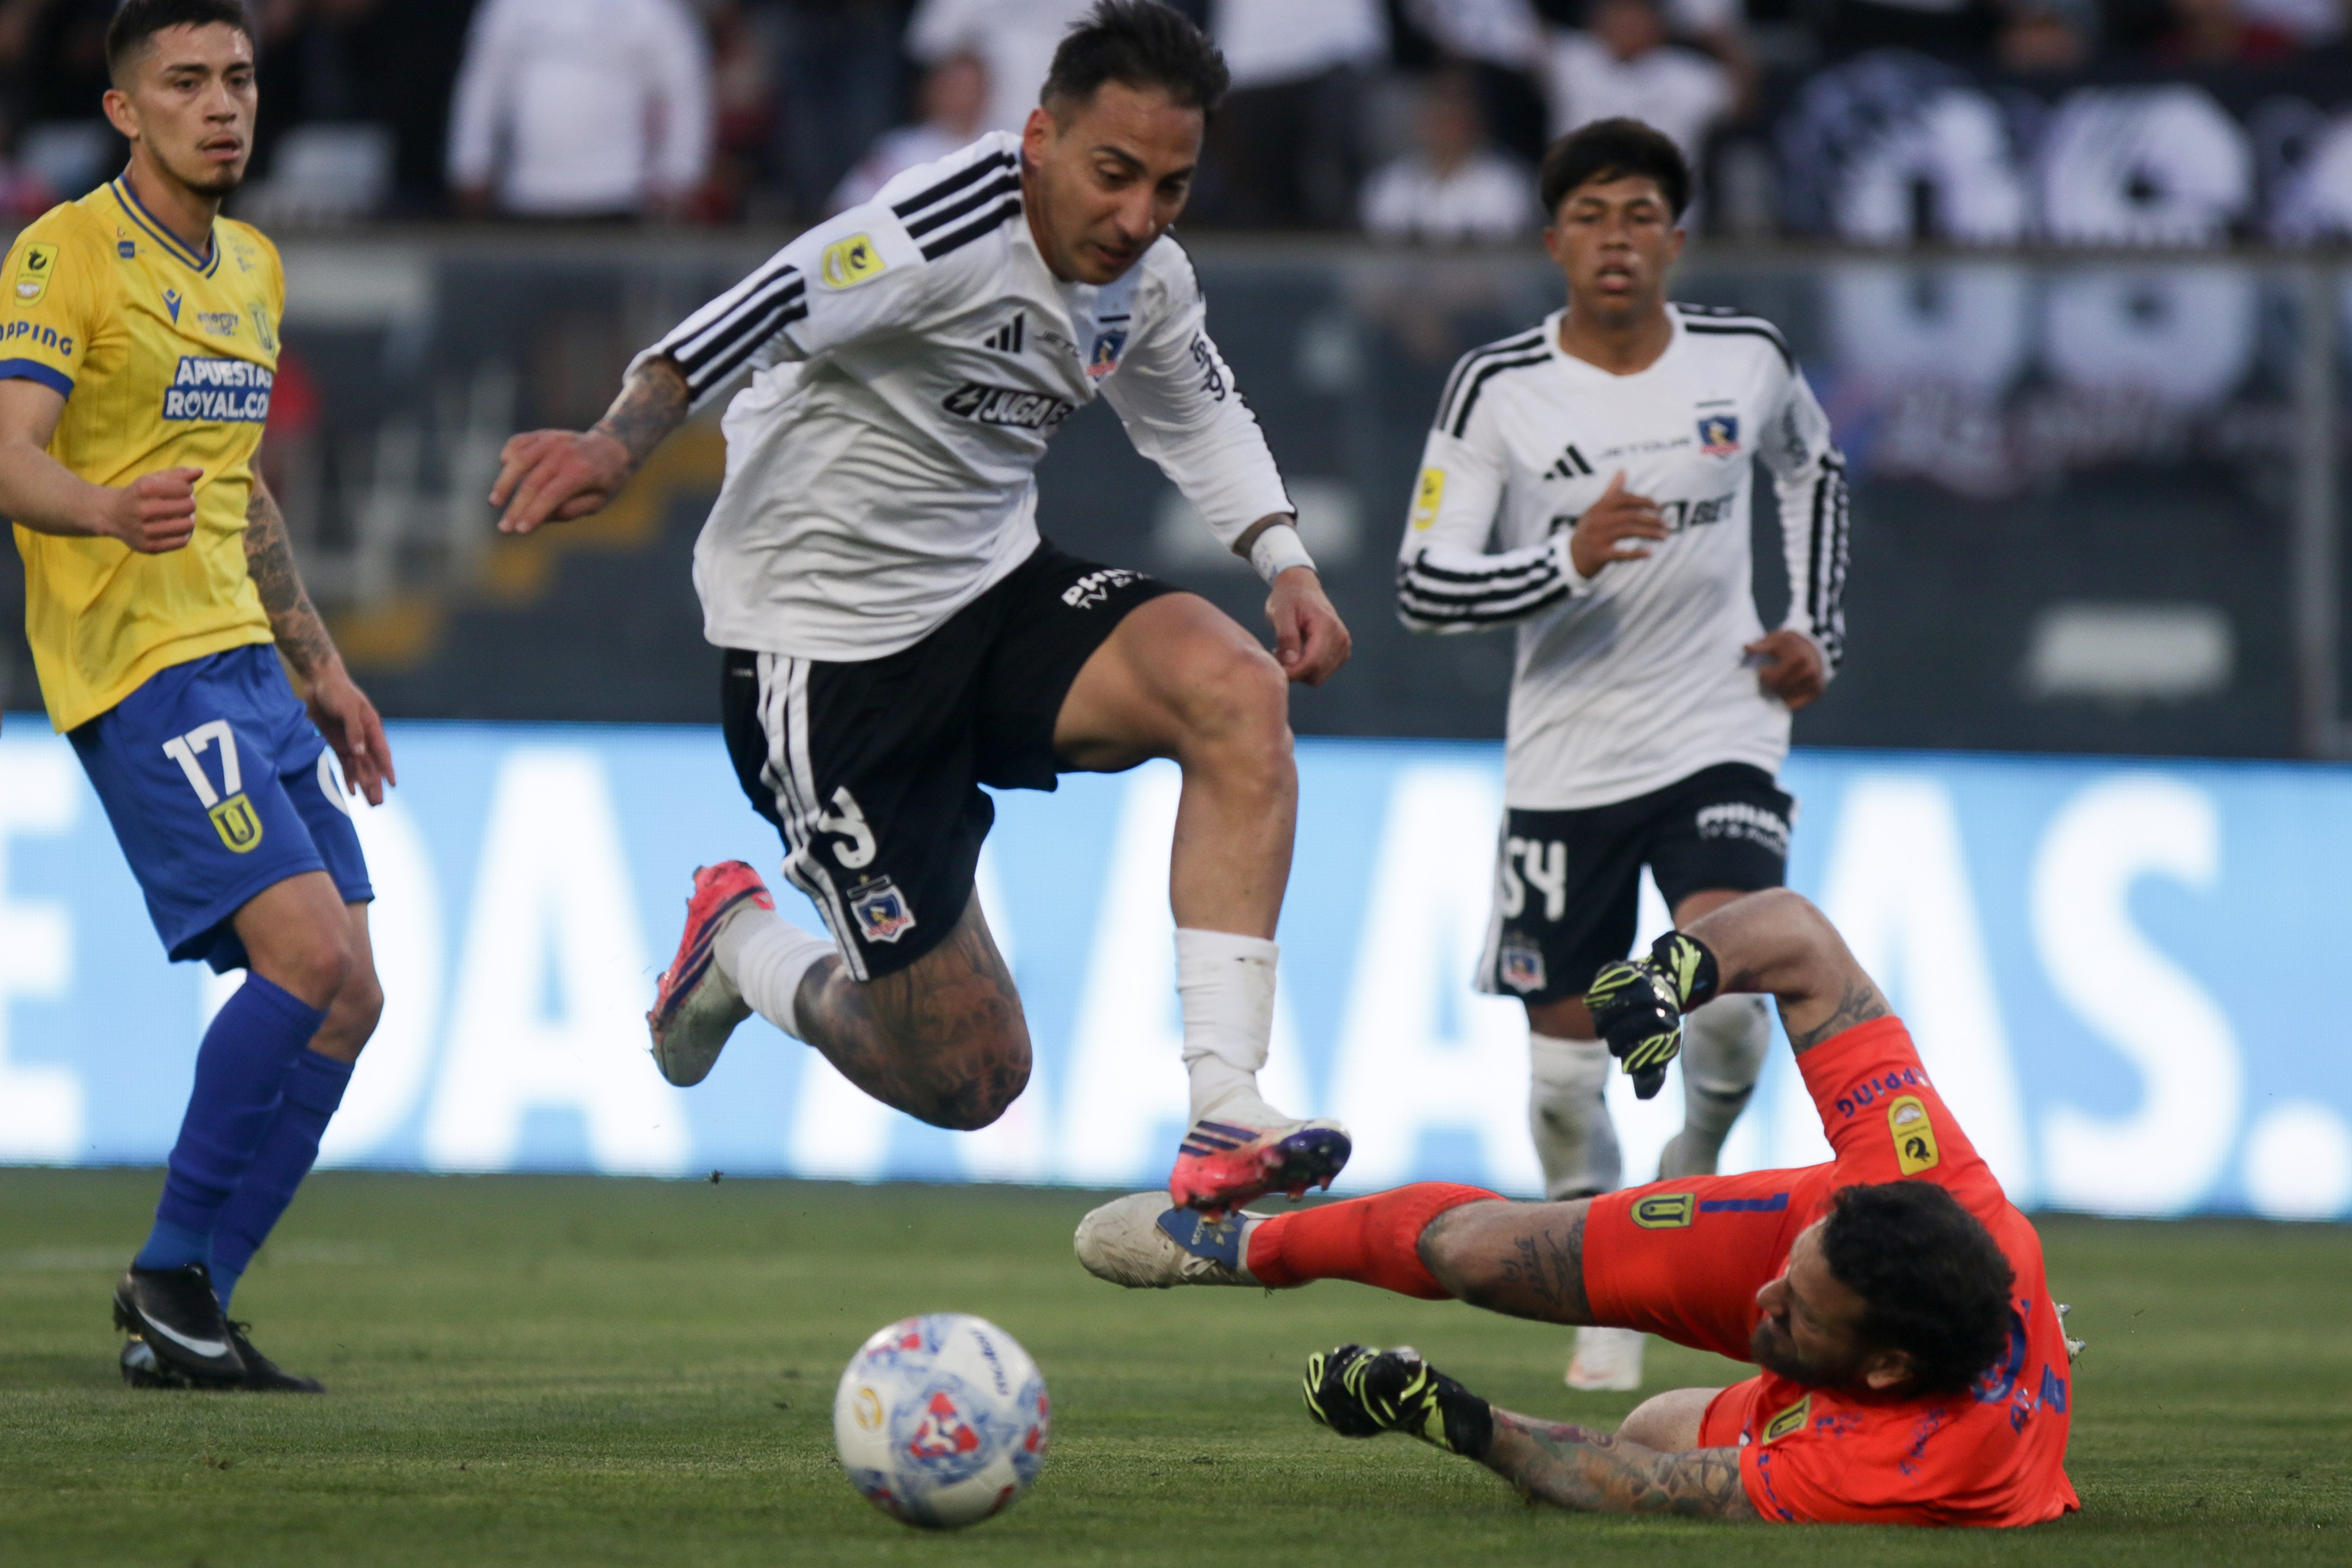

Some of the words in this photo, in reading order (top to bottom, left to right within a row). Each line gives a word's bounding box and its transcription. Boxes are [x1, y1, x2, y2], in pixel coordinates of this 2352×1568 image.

[0, 320, 73, 357] PPING
[162, 719, 242, 809] 17
[1501, 836, 1567, 922] 54
